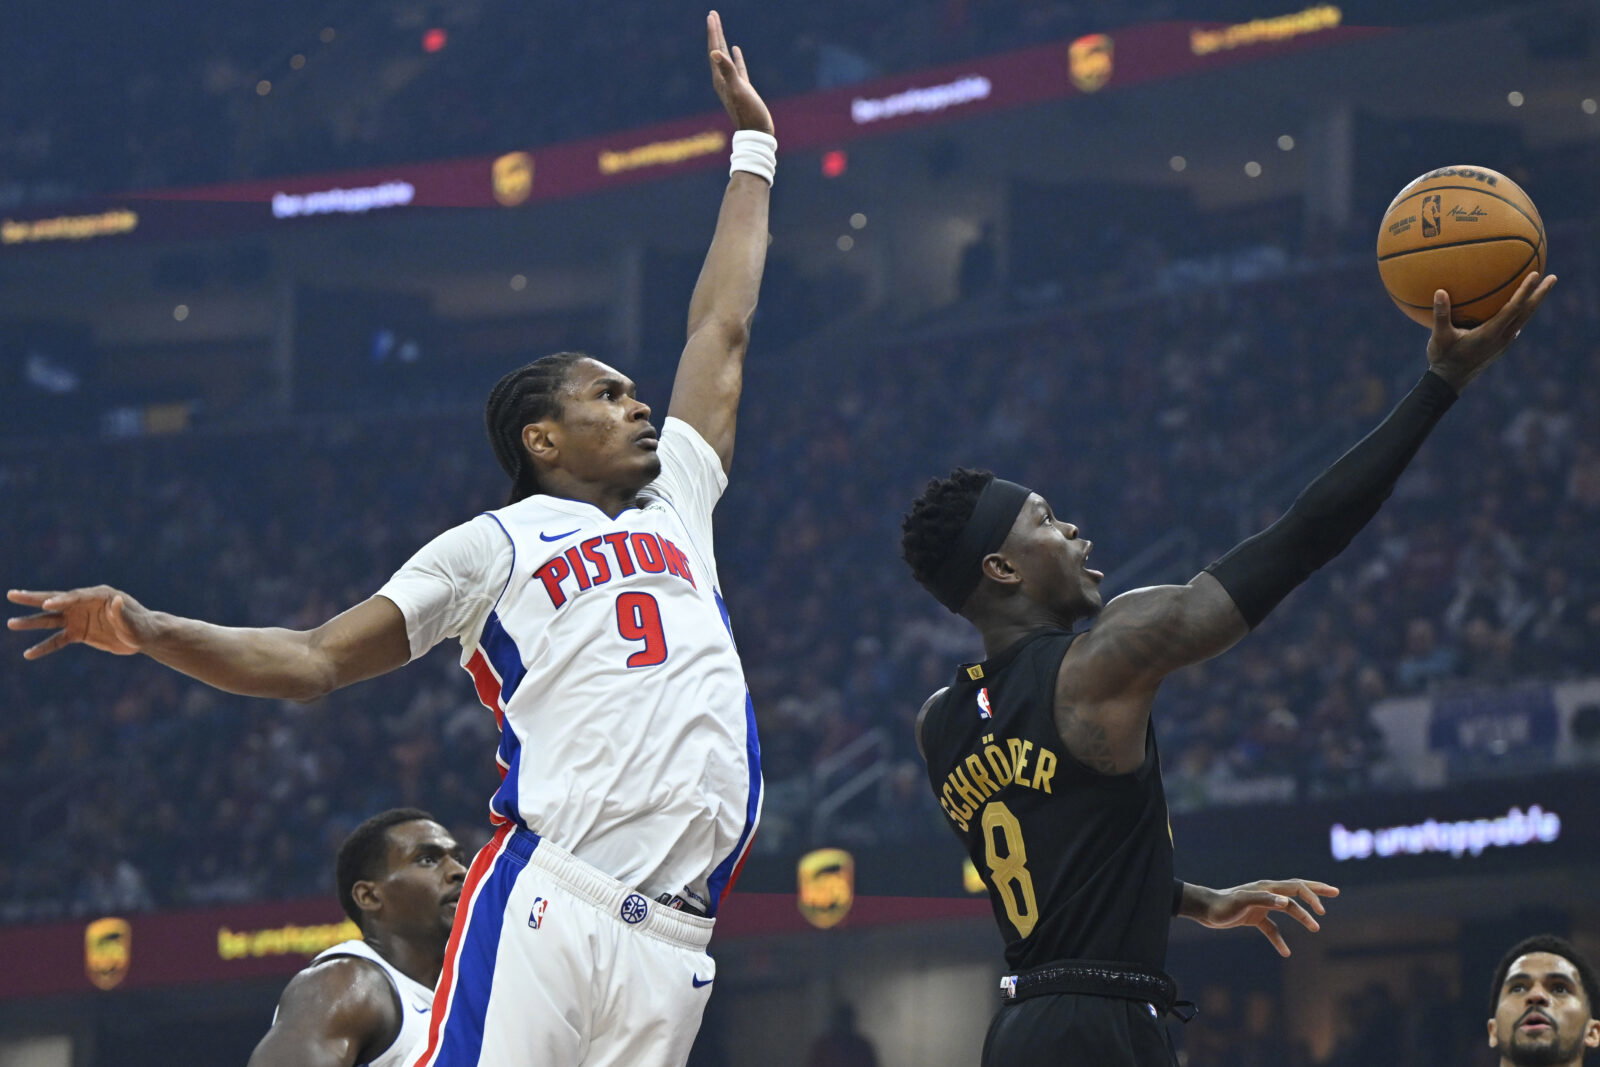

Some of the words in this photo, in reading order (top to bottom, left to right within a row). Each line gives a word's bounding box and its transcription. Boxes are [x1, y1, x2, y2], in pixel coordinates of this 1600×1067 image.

[615, 591, 668, 668] 9
[940, 733, 1057, 832] SCHRÖDER
[981, 801, 1039, 939] 8
[1330, 822, 1373, 862] be
[1374, 803, 1561, 859] unstoppable
